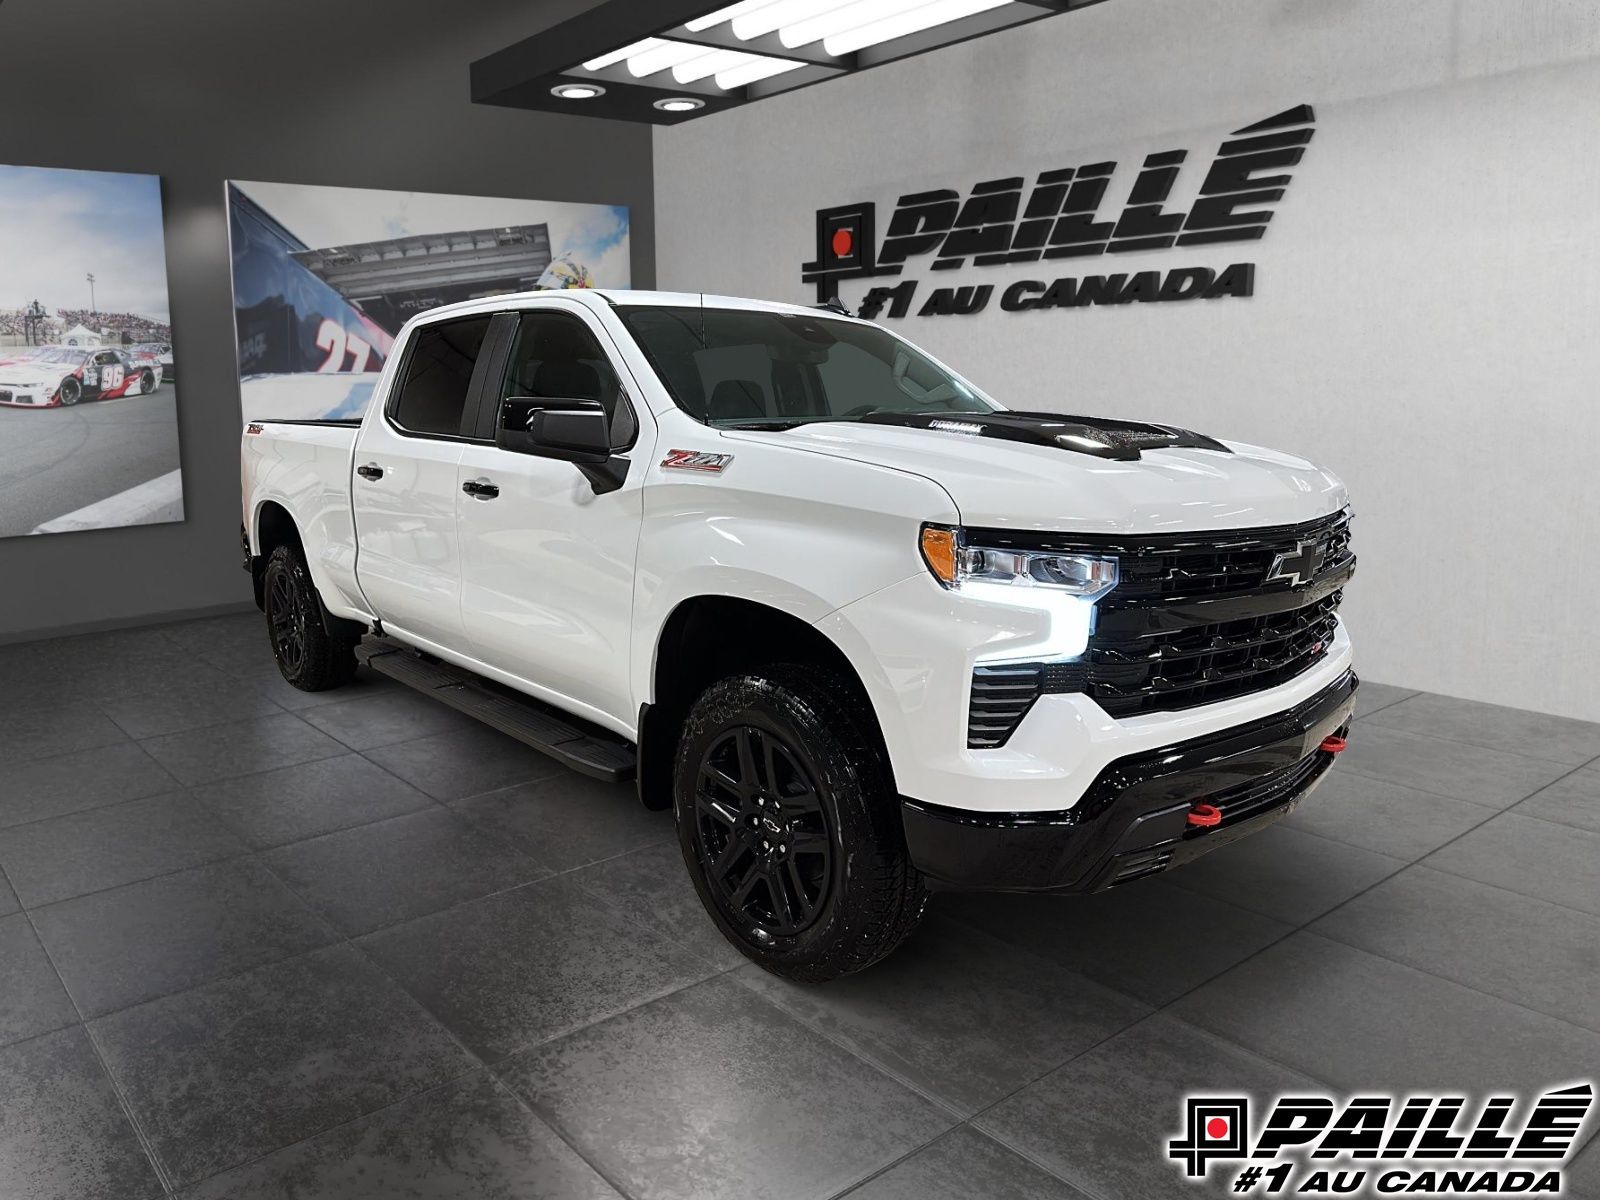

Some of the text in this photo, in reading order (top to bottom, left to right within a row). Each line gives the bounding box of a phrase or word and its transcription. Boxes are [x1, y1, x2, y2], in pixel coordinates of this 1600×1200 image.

[877, 103, 1315, 270] PAILLÉ
[858, 262, 1255, 319] #1 AU CANADA
[315, 318, 371, 373] 27
[101, 363, 125, 391] 96
